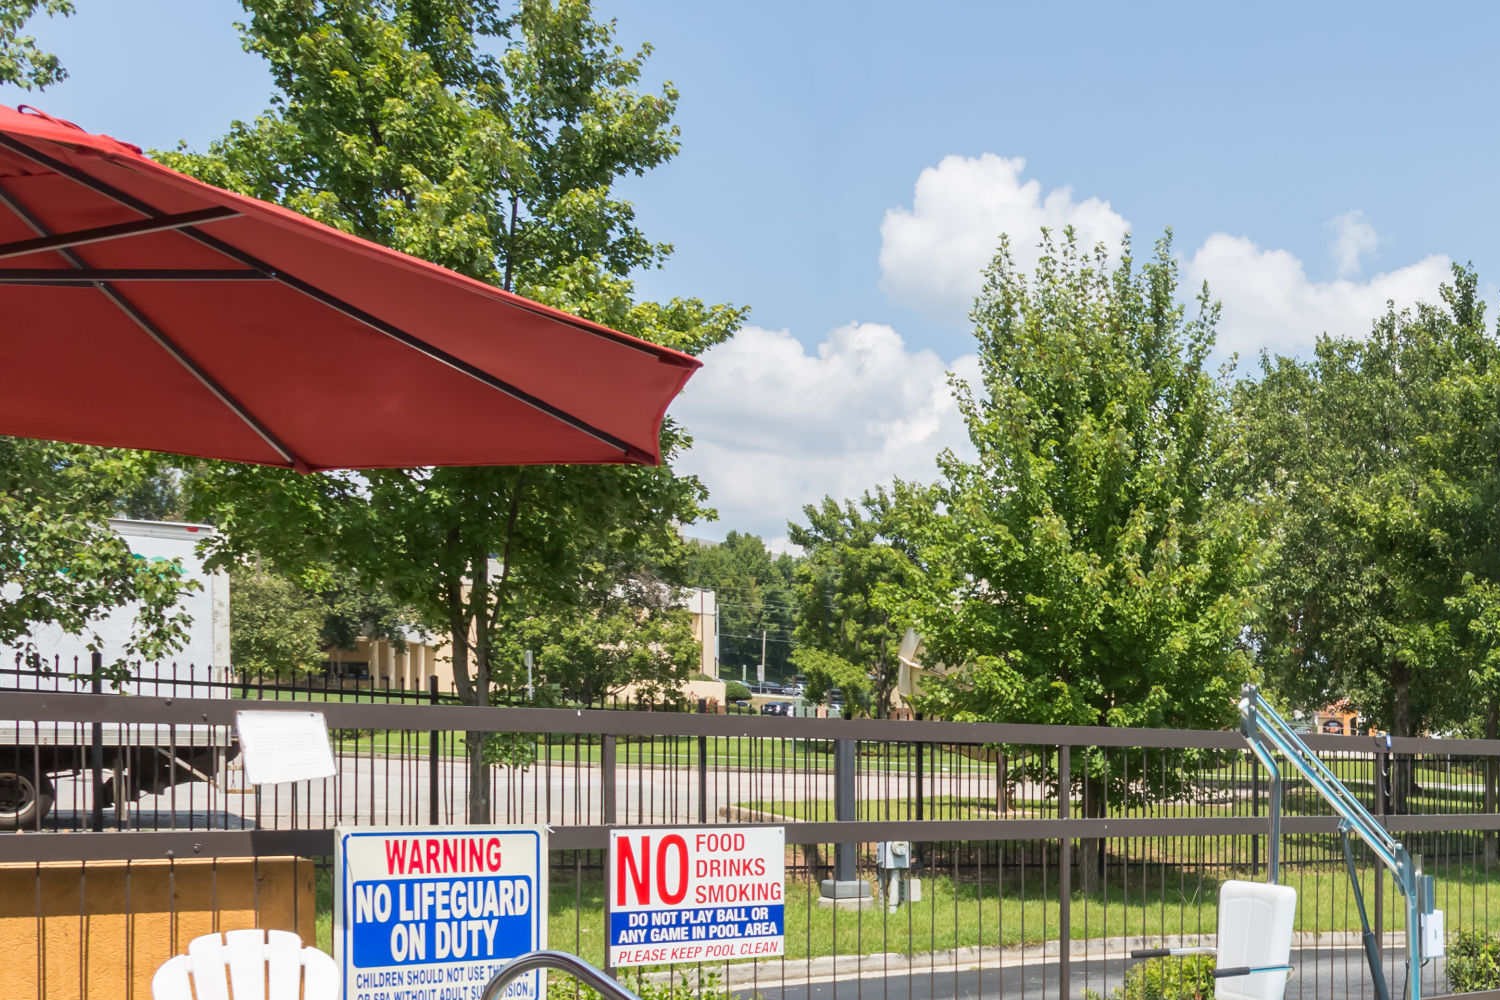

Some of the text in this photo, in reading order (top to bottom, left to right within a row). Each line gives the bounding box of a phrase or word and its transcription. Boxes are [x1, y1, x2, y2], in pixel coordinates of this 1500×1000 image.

[696, 833, 745, 852] FOOD
[385, 838, 501, 875] WARNING
[617, 834, 689, 906] NO
[696, 858, 765, 878] DRINKS
[356, 879, 530, 923] NO LIFEGUARD
[695, 882, 781, 904] SMOKING
[629, 907, 768, 927] DO NOT PLAY BALL OR
[390, 919, 498, 962] ON DUTY
[618, 922, 777, 943] ANY GAME IN POOL AREA
[618, 941, 778, 963] PLEASE KEEP POOL CLEAN
[357, 970, 403, 989] CHILDREN
[407, 969, 443, 985] SHOULD
[447, 967, 464, 982] NOT
[468, 965, 484, 981] USE
[487, 964, 504, 980] TH
